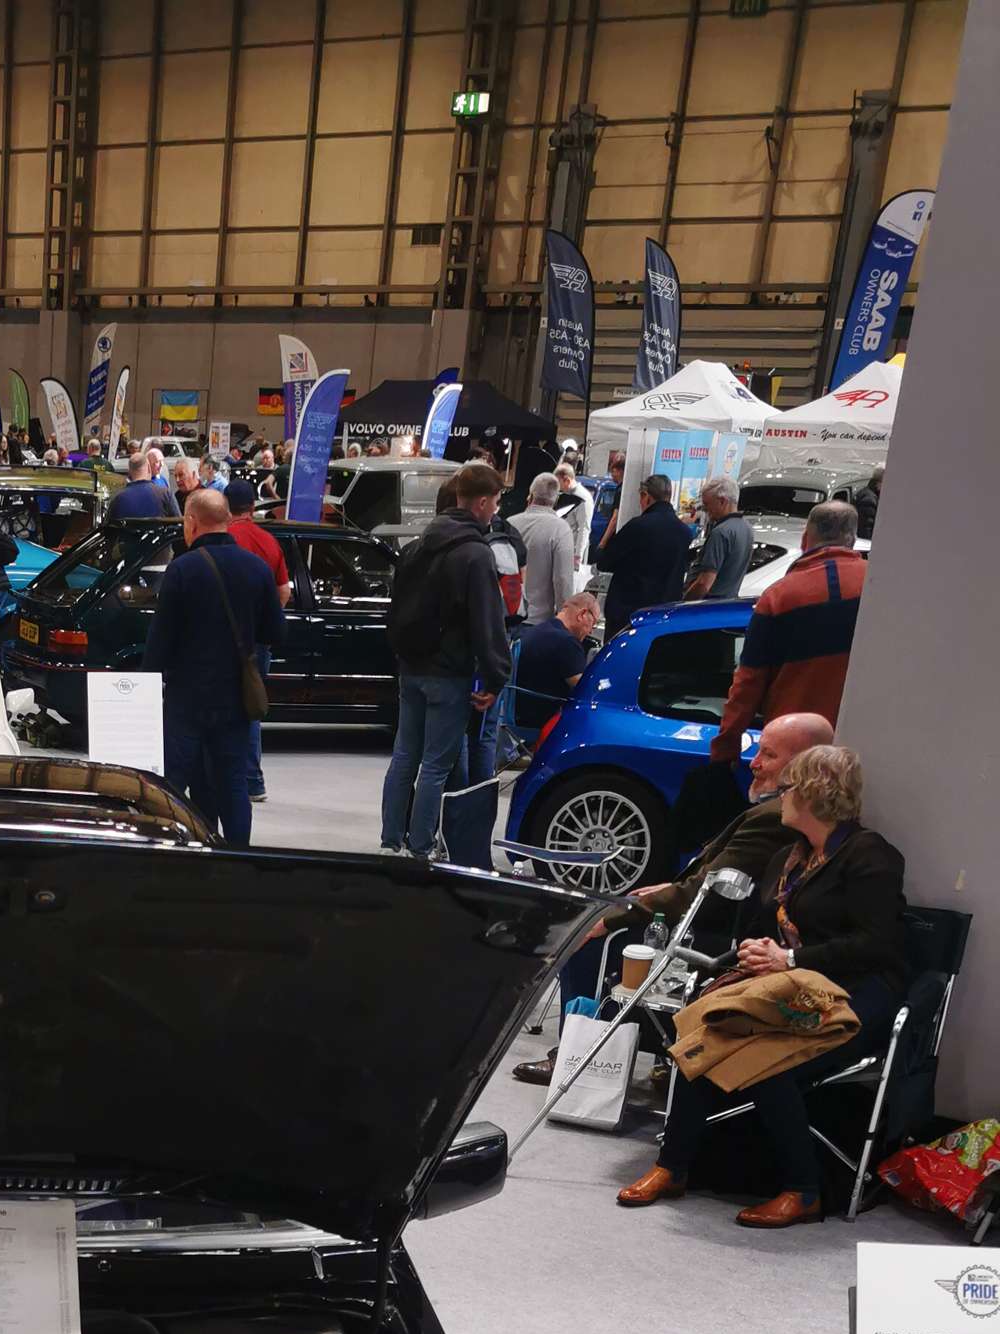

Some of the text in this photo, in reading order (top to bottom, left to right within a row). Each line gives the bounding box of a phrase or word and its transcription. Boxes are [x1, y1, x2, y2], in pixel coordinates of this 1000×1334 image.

[849, 268, 880, 355] OWNERS CLUB
[863, 269, 898, 351] SAAB
[349, 423, 469, 437] VOLVO OWNE LUB
[765, 428, 808, 438] AUSTIN
[839, 432, 855, 440] can
[856, 430, 889, 444] depend
[566, 1055, 623, 1069] JAUAR
[963, 1282, 999, 1300] PRIDE
